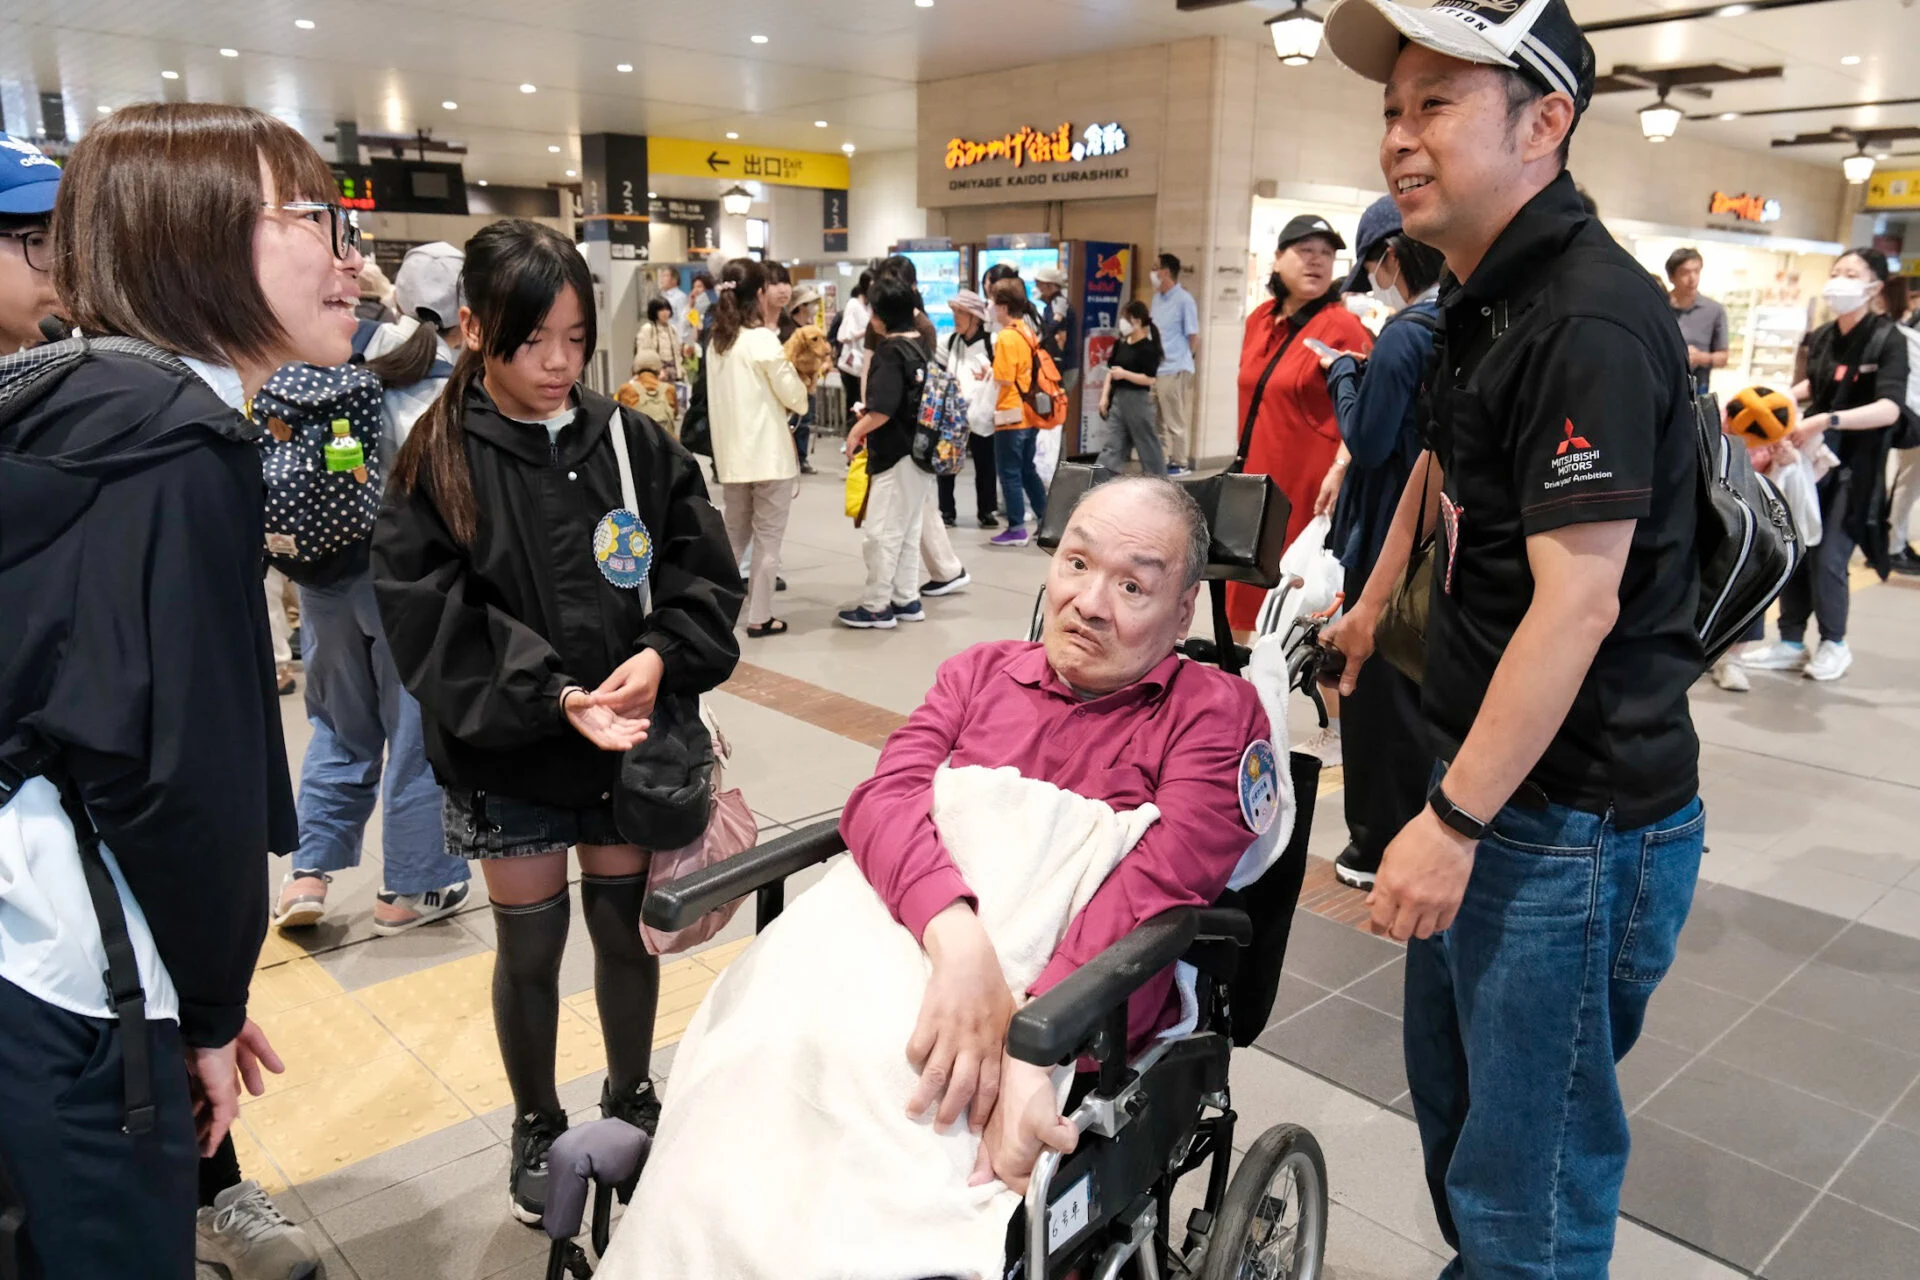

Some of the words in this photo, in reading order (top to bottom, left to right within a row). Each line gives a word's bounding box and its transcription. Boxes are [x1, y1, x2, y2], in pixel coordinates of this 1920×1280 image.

[744, 154, 781, 177] 出口
[783, 158, 803, 170] Exit
[949, 177, 1003, 191] OMIYAGE
[1007, 174, 1047, 186] KAIDO
[1051, 168, 1130, 183] KURASHIKI
[622, 180, 633, 198] 2
[623, 199, 634, 216] 3
[831, 198, 840, 213] 2
[1551, 450, 1600, 468] MITSUBISHI
[1557, 461, 1593, 477] MOTORS
[1573, 471, 1613, 482] Ambition
